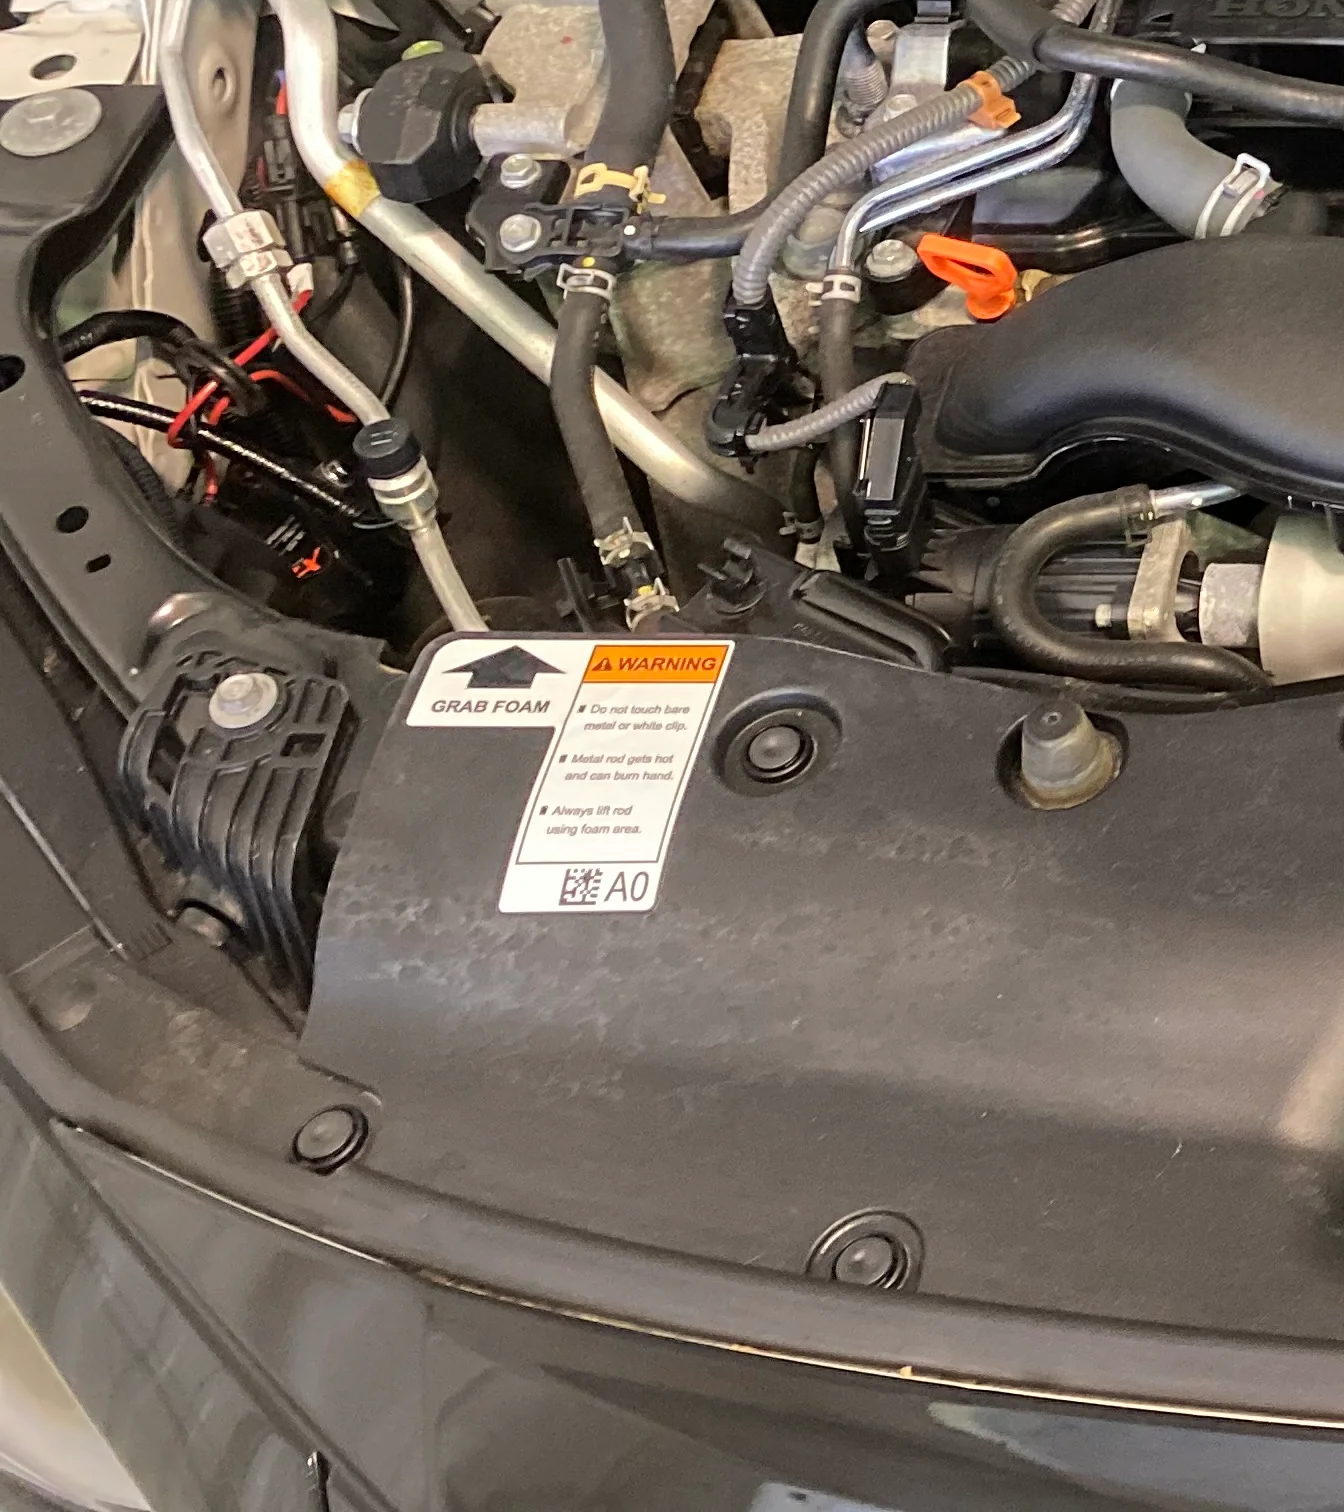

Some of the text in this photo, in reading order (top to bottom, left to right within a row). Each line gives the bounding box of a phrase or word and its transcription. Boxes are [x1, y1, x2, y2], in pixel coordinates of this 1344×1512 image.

[618, 657, 717, 671] WARNING
[431, 700, 551, 714] GRAB FOAM
[590, 704, 690, 715] Do not touch bare
[583, 721, 687, 733] metal or white clip.
[571, 754, 674, 766] Metal rod gets hot
[564, 771, 675, 781] and can burn hand.
[551, 805, 633, 817] Always lift rod
[545, 823, 642, 837] using foam area.
[603, 870, 650, 902] A0
